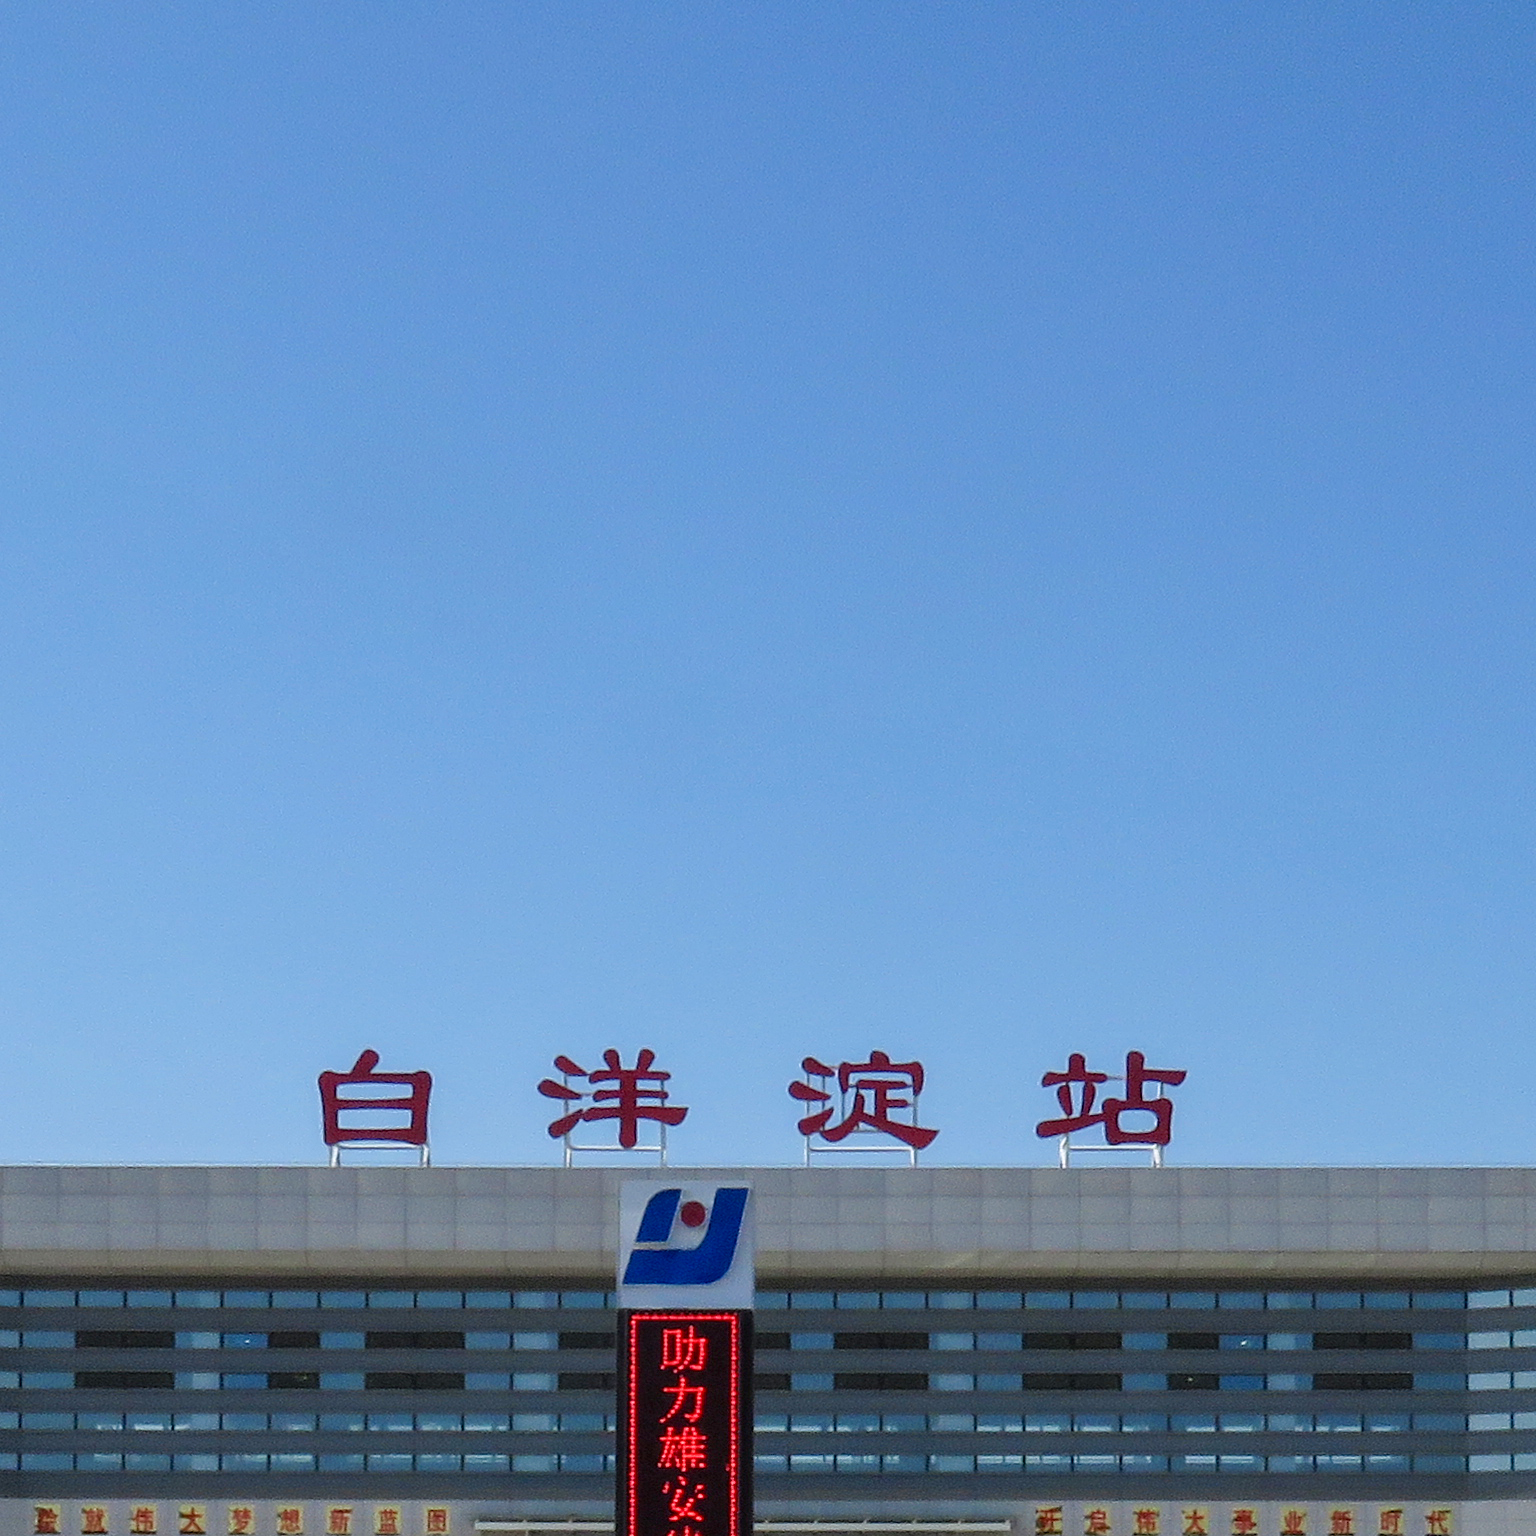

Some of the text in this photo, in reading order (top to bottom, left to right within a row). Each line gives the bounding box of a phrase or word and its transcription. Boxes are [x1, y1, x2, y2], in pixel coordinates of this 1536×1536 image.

[318, 1048, 1188, 1149] 白洋淀站
[1035, 1506, 1454, 1535] 开启伟大事业新时代
